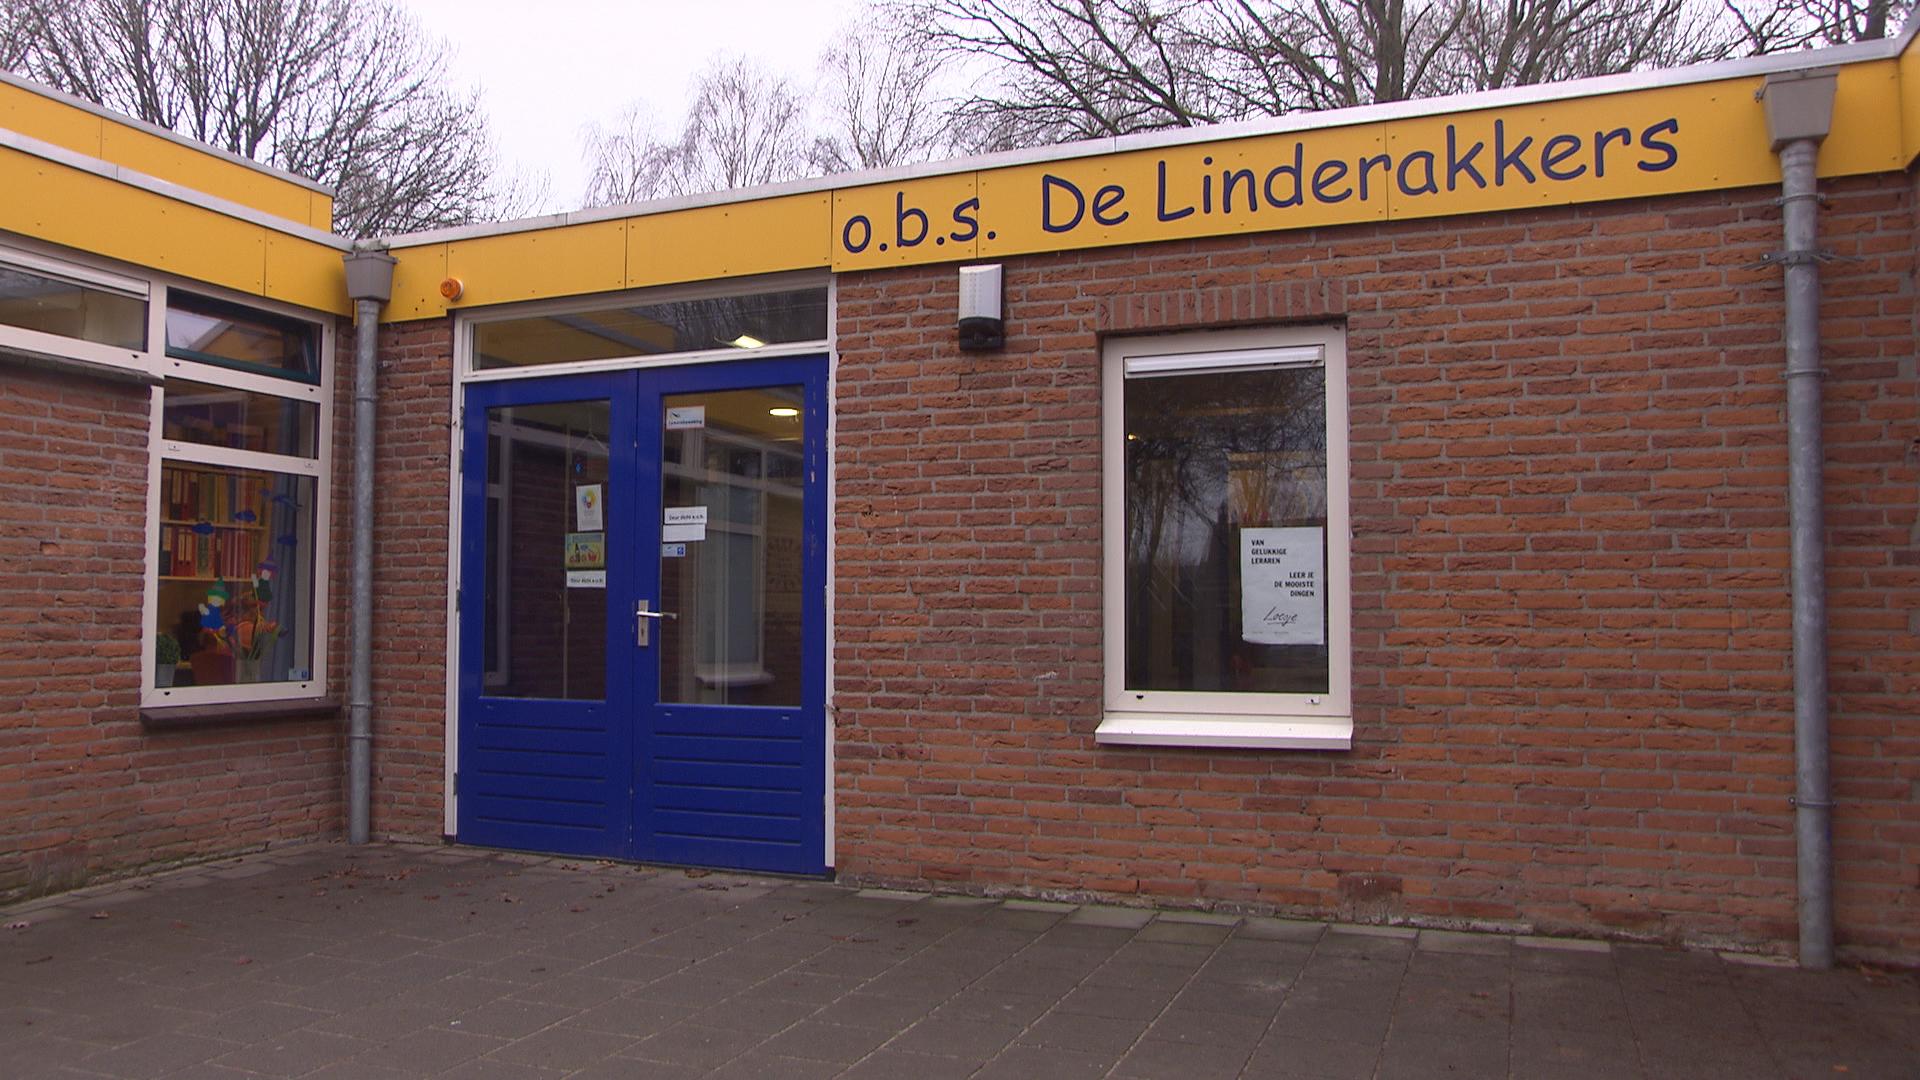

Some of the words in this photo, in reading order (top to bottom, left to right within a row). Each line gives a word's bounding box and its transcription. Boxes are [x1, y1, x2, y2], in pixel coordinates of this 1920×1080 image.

[842, 191, 997, 254] o.b.s.
[1042, 173, 1129, 233] De
[1157, 117, 1679, 222] Linderakkers
[1251, 548, 1287, 556] GELUKKIGE
[1251, 557, 1281, 565] LERAREN
[1289, 571, 1305, 579] LEER
[1307, 571, 1314, 579] JE
[1284, 580, 1315, 588] MOOISTE
